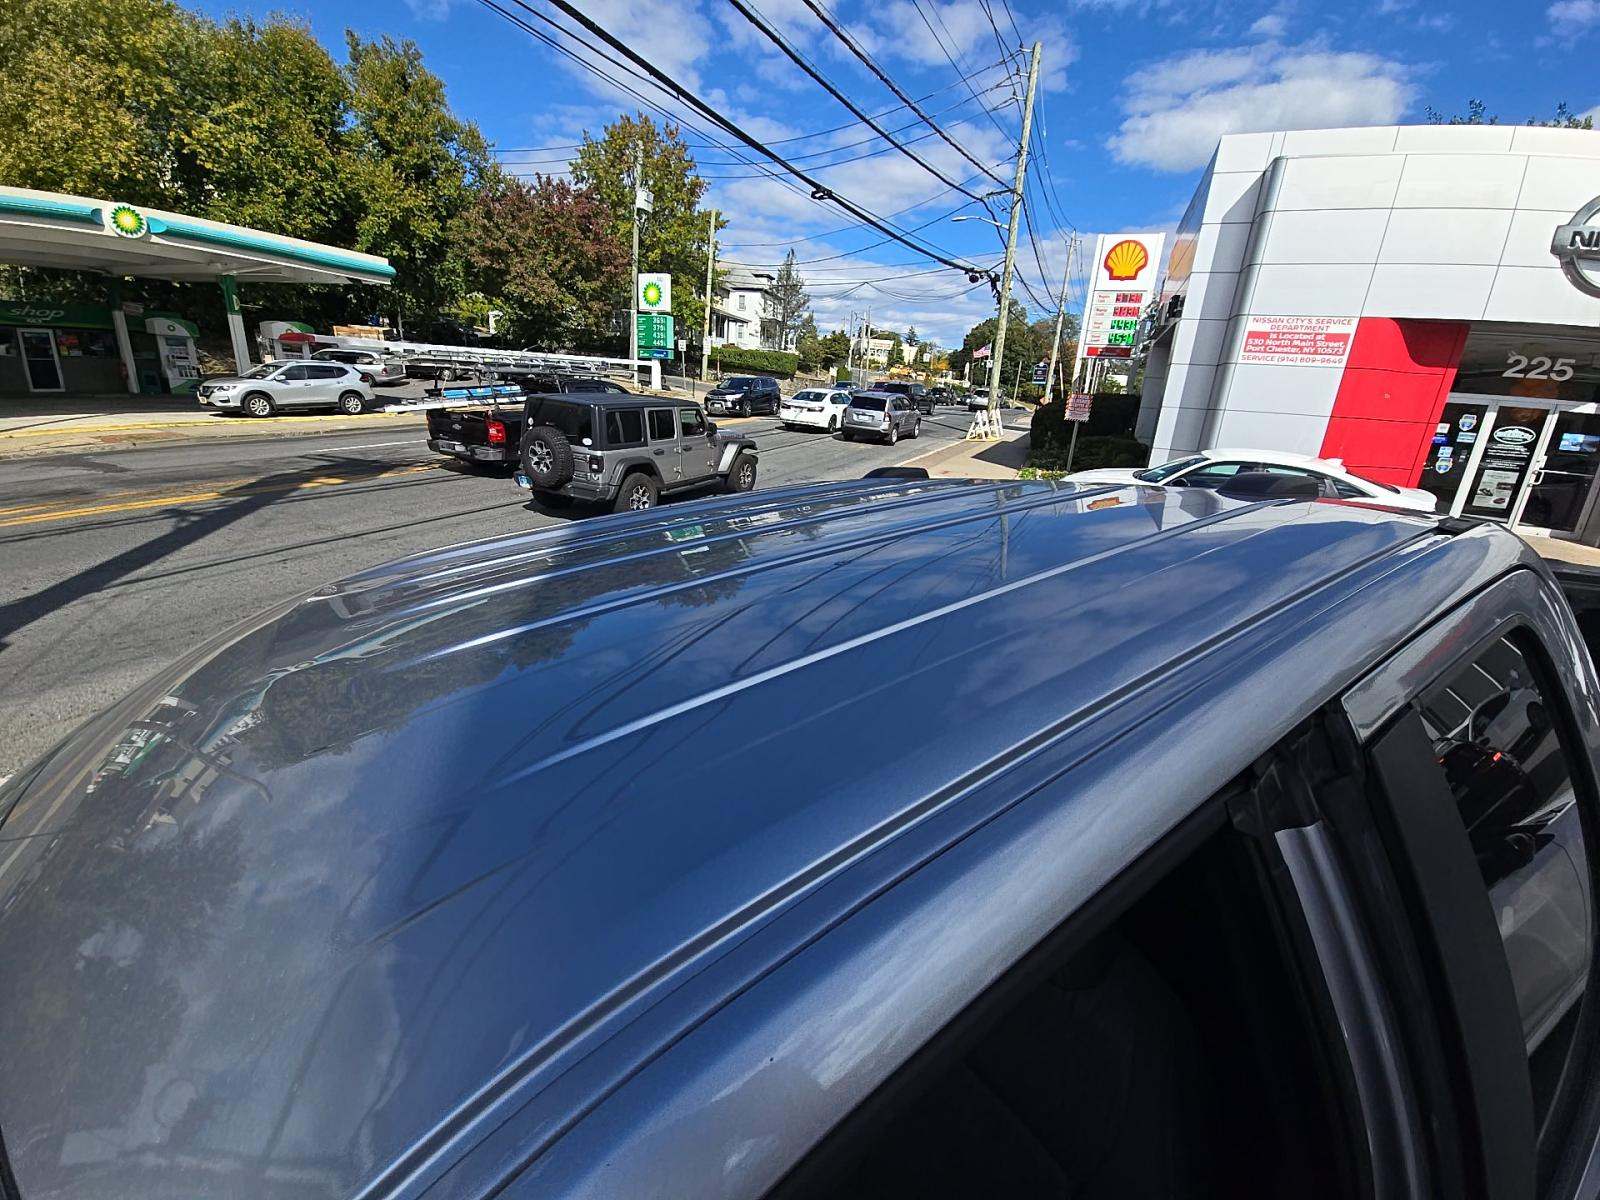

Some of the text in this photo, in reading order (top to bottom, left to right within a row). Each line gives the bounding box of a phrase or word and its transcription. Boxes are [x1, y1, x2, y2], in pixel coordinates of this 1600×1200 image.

[8, 305, 64, 320] shop
[1315, 318, 1353, 326] SERVICE
[1502, 354, 1576, 381] 225
